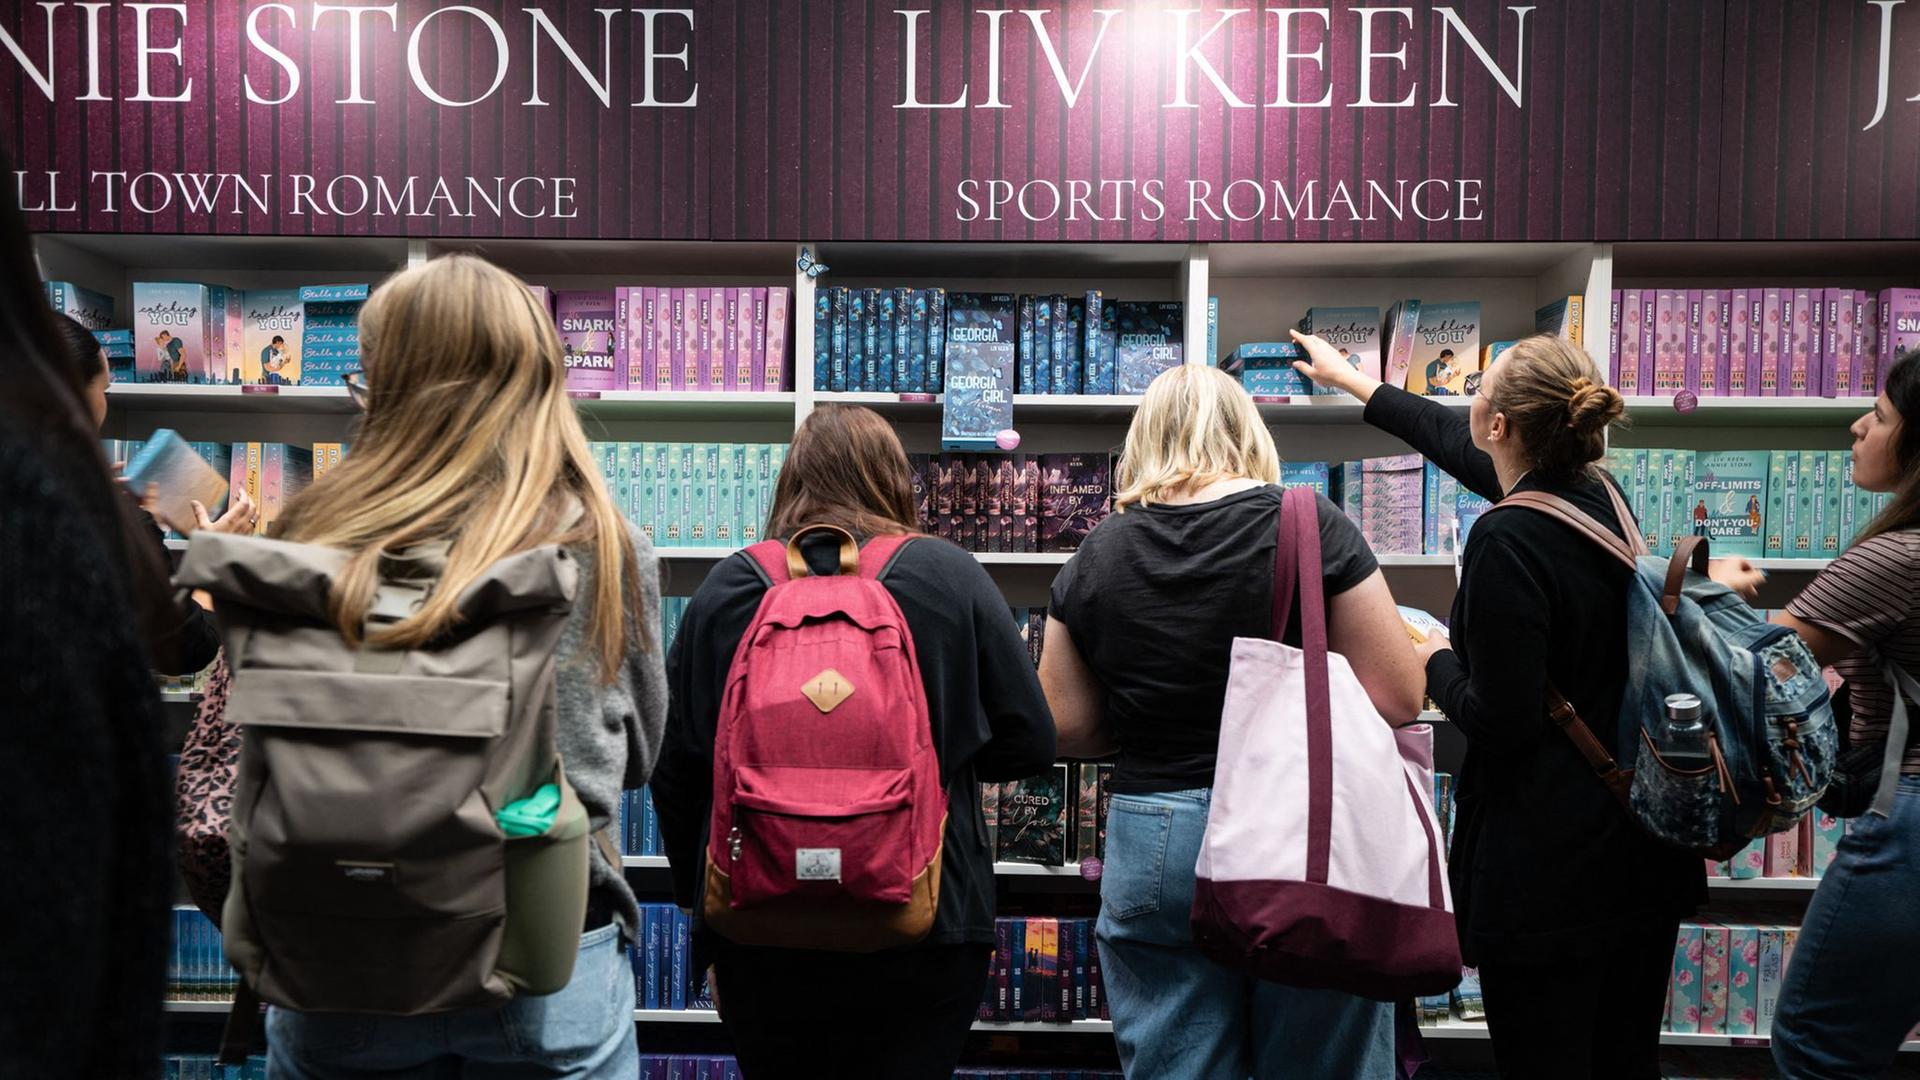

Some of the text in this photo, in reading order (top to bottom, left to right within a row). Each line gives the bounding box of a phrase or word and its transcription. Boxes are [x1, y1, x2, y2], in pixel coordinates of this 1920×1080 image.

[244, 2, 699, 109] STONE
[893, 5, 1536, 109] LIV KEEN
[1863, 0, 1920, 131] J
[91, 171, 271, 216] TOWN
[288, 175, 578, 219] ROMANCE
[955, 178, 1484, 222] SPORTS ROMANCE
[138, 301, 197, 317] catching
[248, 306, 300, 321] tackling
[1207, 302, 1216, 324] YOU
[150, 312, 188, 325] YOU
[257, 318, 293, 330] YOU
[562, 318, 615, 331] SNARK
[952, 327, 998, 342] GEORGIA
[1121, 333, 1167, 347] GEORGIA
[1327, 333, 1367, 343] YOU
[1424, 331, 1464, 345] YOU
[1152, 347, 1177, 360] GIRL
[563, 355, 614, 368] SPARK
[950, 375, 997, 389] GEORGIA
[982, 390, 1008, 403] GIRL
[316, 448, 324, 471] YOU
[1050, 485, 1103, 494] INFLAMED
[1695, 480, 1761, 490] OFF-LIMITS
[1069, 496, 1083, 505] BY
[1719, 490, 1736, 514] &
[1695, 518, 1758, 528] DON'T-YOU-
[1710, 527, 1742, 536] DARE
[1014, 795, 1049, 806] CURED
[1024, 806, 1038, 816] BY
[691, 1000, 716, 1009] ANNI
